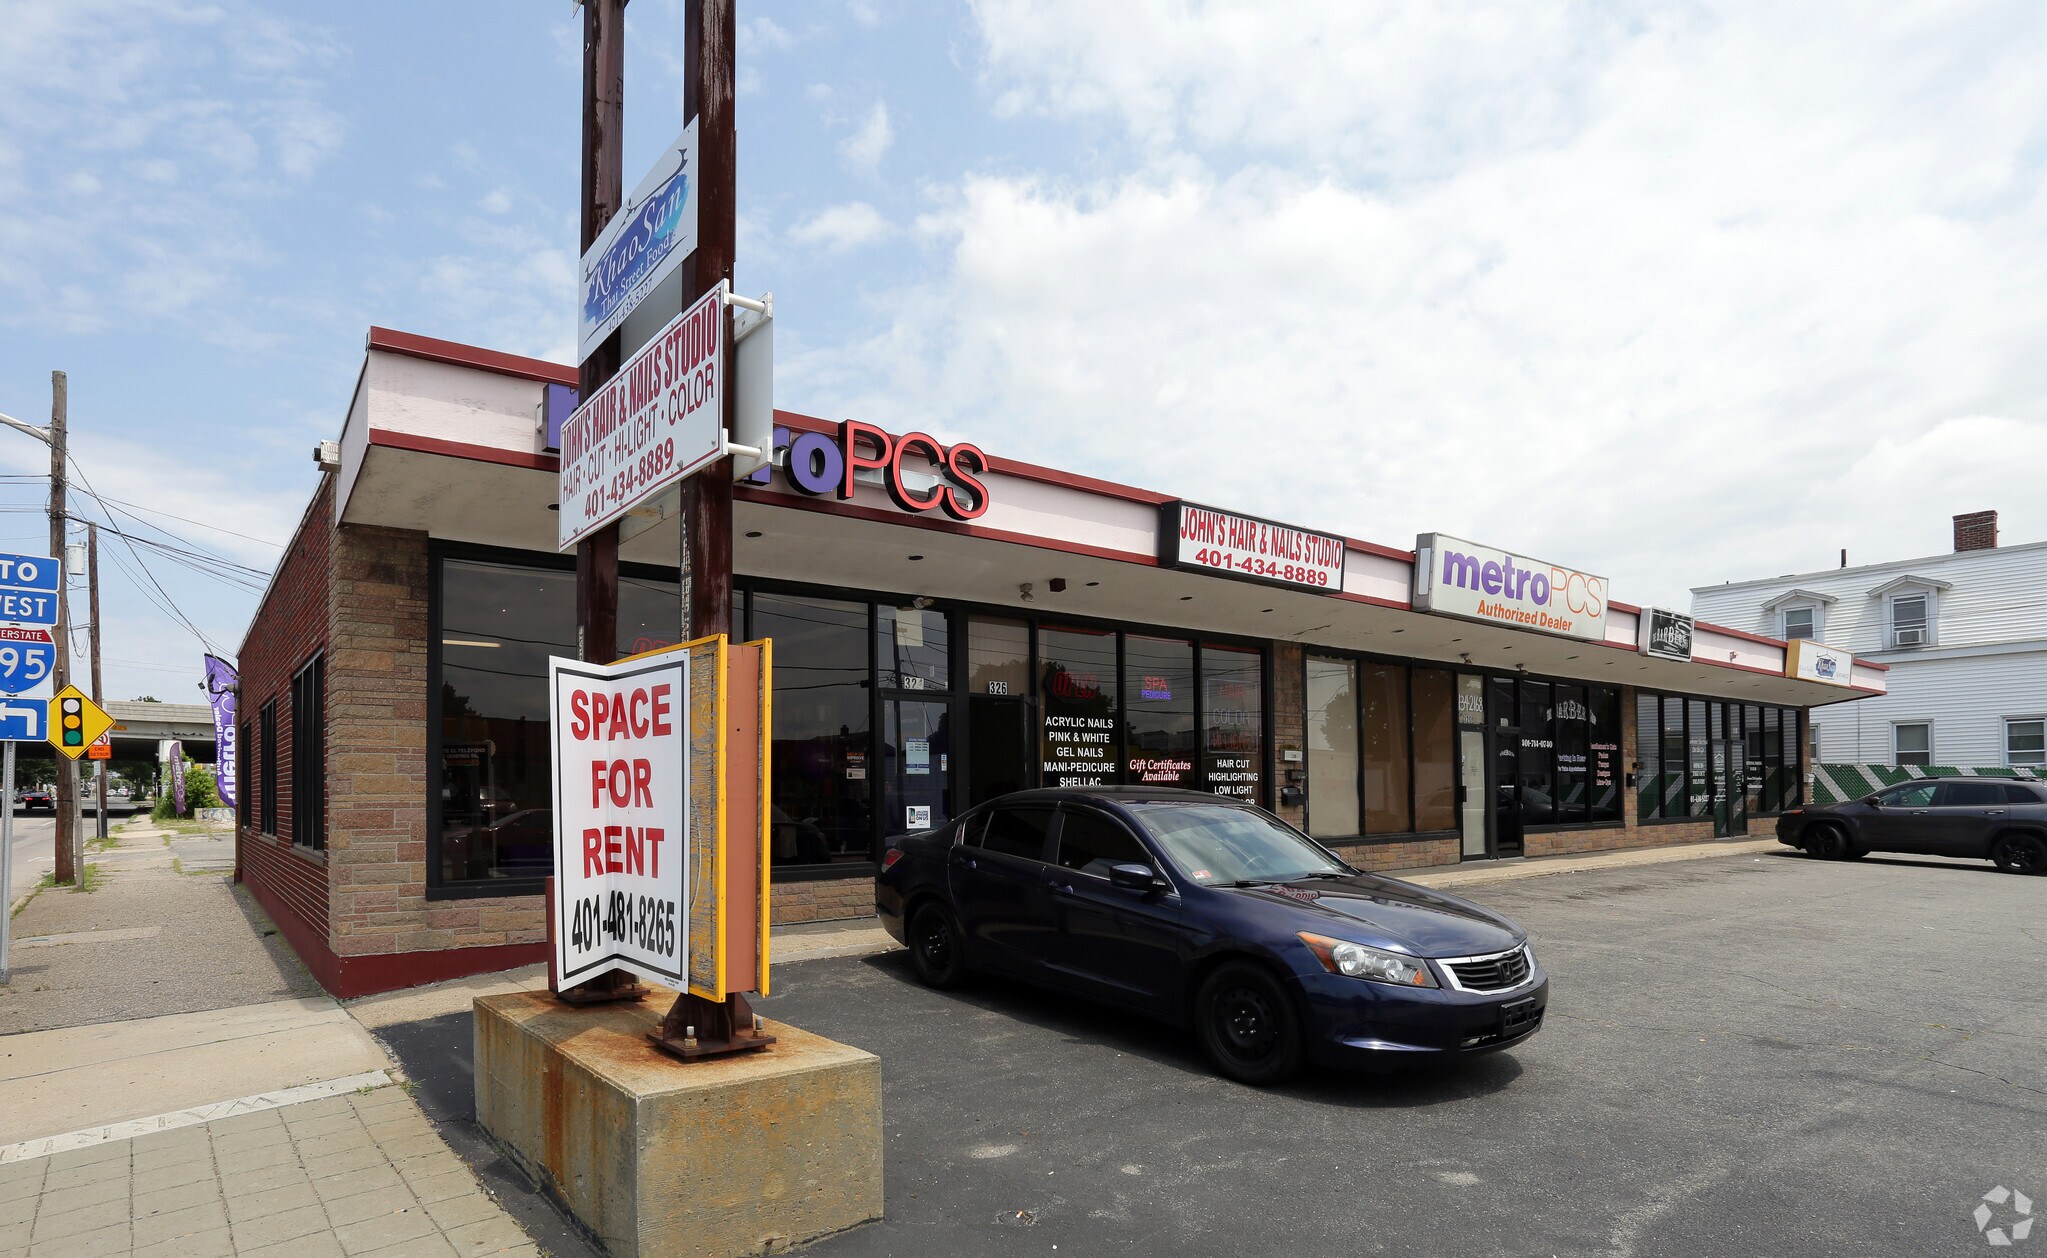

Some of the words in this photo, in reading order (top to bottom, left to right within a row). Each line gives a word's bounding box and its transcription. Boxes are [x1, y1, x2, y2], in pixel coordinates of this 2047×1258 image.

[600, 286, 618, 315] Thai
[620, 263, 644, 295] Street
[646, 231, 670, 266] Food
[607, 278, 653, 332] 401-438-5227
[562, 406, 591, 473] JOHN'S
[592, 385, 616, 447] HAIR
[618, 382, 627, 426] &
[629, 344, 662, 419] NAILS
[664, 298, 717, 390] STUDIO
[562, 464, 581, 505] HAIR
[587, 443, 606, 485] CUT
[614, 402, 658, 467] HI-LIGHT
[668, 361, 714, 427] COLOR
[584, 436, 674, 520] 401-434-8889
[1181, 507, 1226, 547] JOHN'S
[1228, 517, 1257, 553] HAIR
[1259, 524, 1267, 555] &
[1271, 526, 1302, 562] NAILS
[1304, 534, 1342, 570] STUDIO
[0, 560, 38, 582] TO
[1195, 548, 1328, 586] 401-434-8889
[1442, 550, 1602, 618] metroPCS
[0, 595, 47, 618] EST
[1477, 599, 1538, 625] Authorized
[1539, 612, 1573, 632] Dealer
[0, 630, 43, 641] ERSTATE
[989, 681, 1008, 695] 326
[1144, 675, 1168, 691] SPA
[570, 683, 672, 742] SPACE
[1045, 716, 1085, 728] ACRYLIC
[1087, 718, 1114, 729] NAILS
[1049, 731, 1071, 742] PINK
[1073, 732, 1080, 742] &
[1082, 733, 1110, 743] WHITE
[1056, 747, 1075, 757] GEL
[1077, 748, 1104, 758] NAILS
[1044, 762, 1115, 773] MANI-PEDICURE
[1129, 759, 1146, 773] Gift
[1147, 760, 1192, 773] Certificates
[1216, 759, 1235, 769] HAIR
[1236, 760, 1250, 769] CUT
[590, 758, 654, 809] FOR
[1059, 777, 1101, 788] SHELLAC
[1141, 770, 1180, 782] Available
[1208, 772, 1259, 782] HIGHLIGHTING
[1214, 786, 1231, 795] LOW
[1232, 786, 1253, 795] LIGHT
[583, 825, 665, 879] RENT
[572, 889, 675, 958] 401-481-8265
